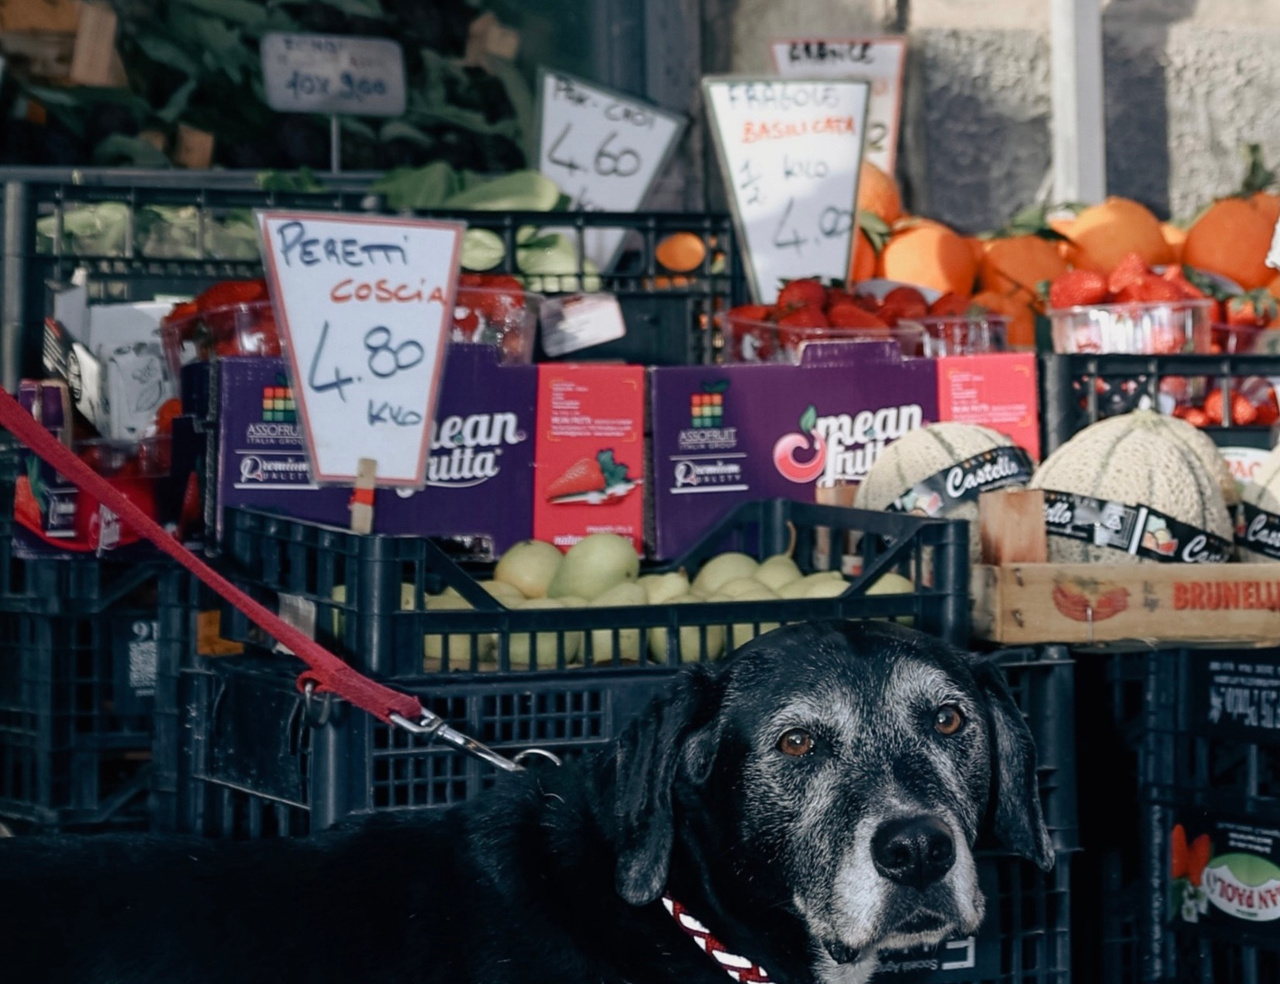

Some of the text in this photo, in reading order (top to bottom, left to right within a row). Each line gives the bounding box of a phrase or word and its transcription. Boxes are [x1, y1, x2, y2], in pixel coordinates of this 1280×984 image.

[246, 423, 299, 436] ASSOFRU
[814, 404, 923, 450] mean
[946, 456, 1019, 499] Castello
